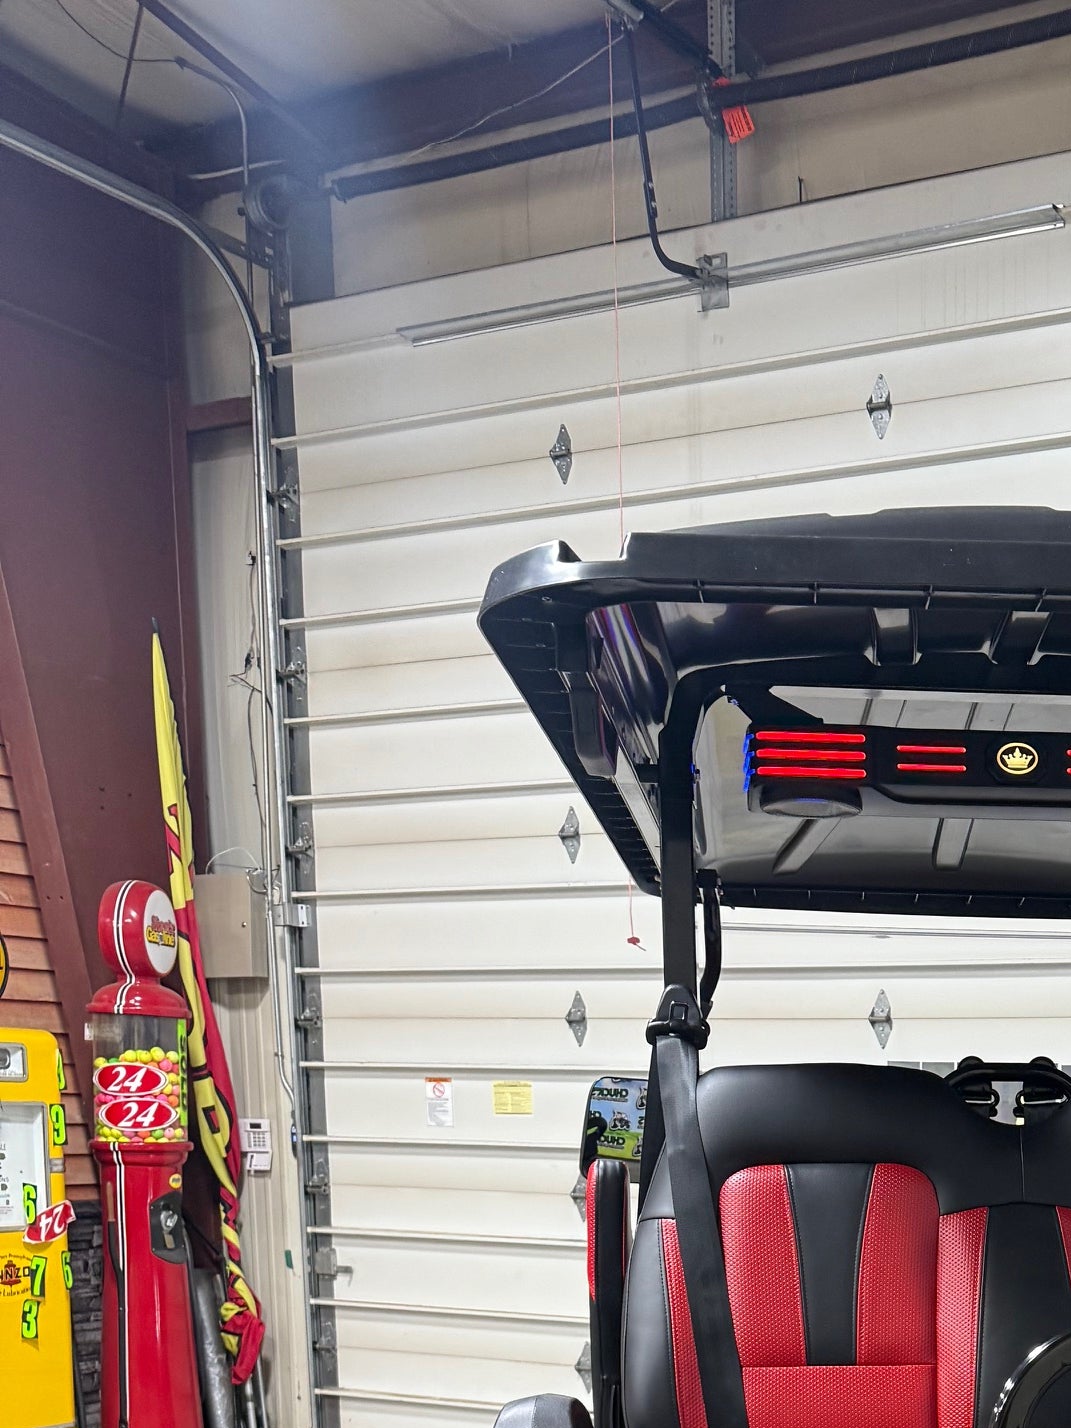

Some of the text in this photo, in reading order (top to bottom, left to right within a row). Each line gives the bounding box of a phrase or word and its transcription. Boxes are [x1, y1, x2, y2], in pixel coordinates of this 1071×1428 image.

[107, 1066, 144, 1092] 24
[118, 1102, 156, 1127] 24
[24, 1185, 36, 1225] 6
[31, 1257, 45, 1296] 7
[22, 1300, 38, 1338] 3
